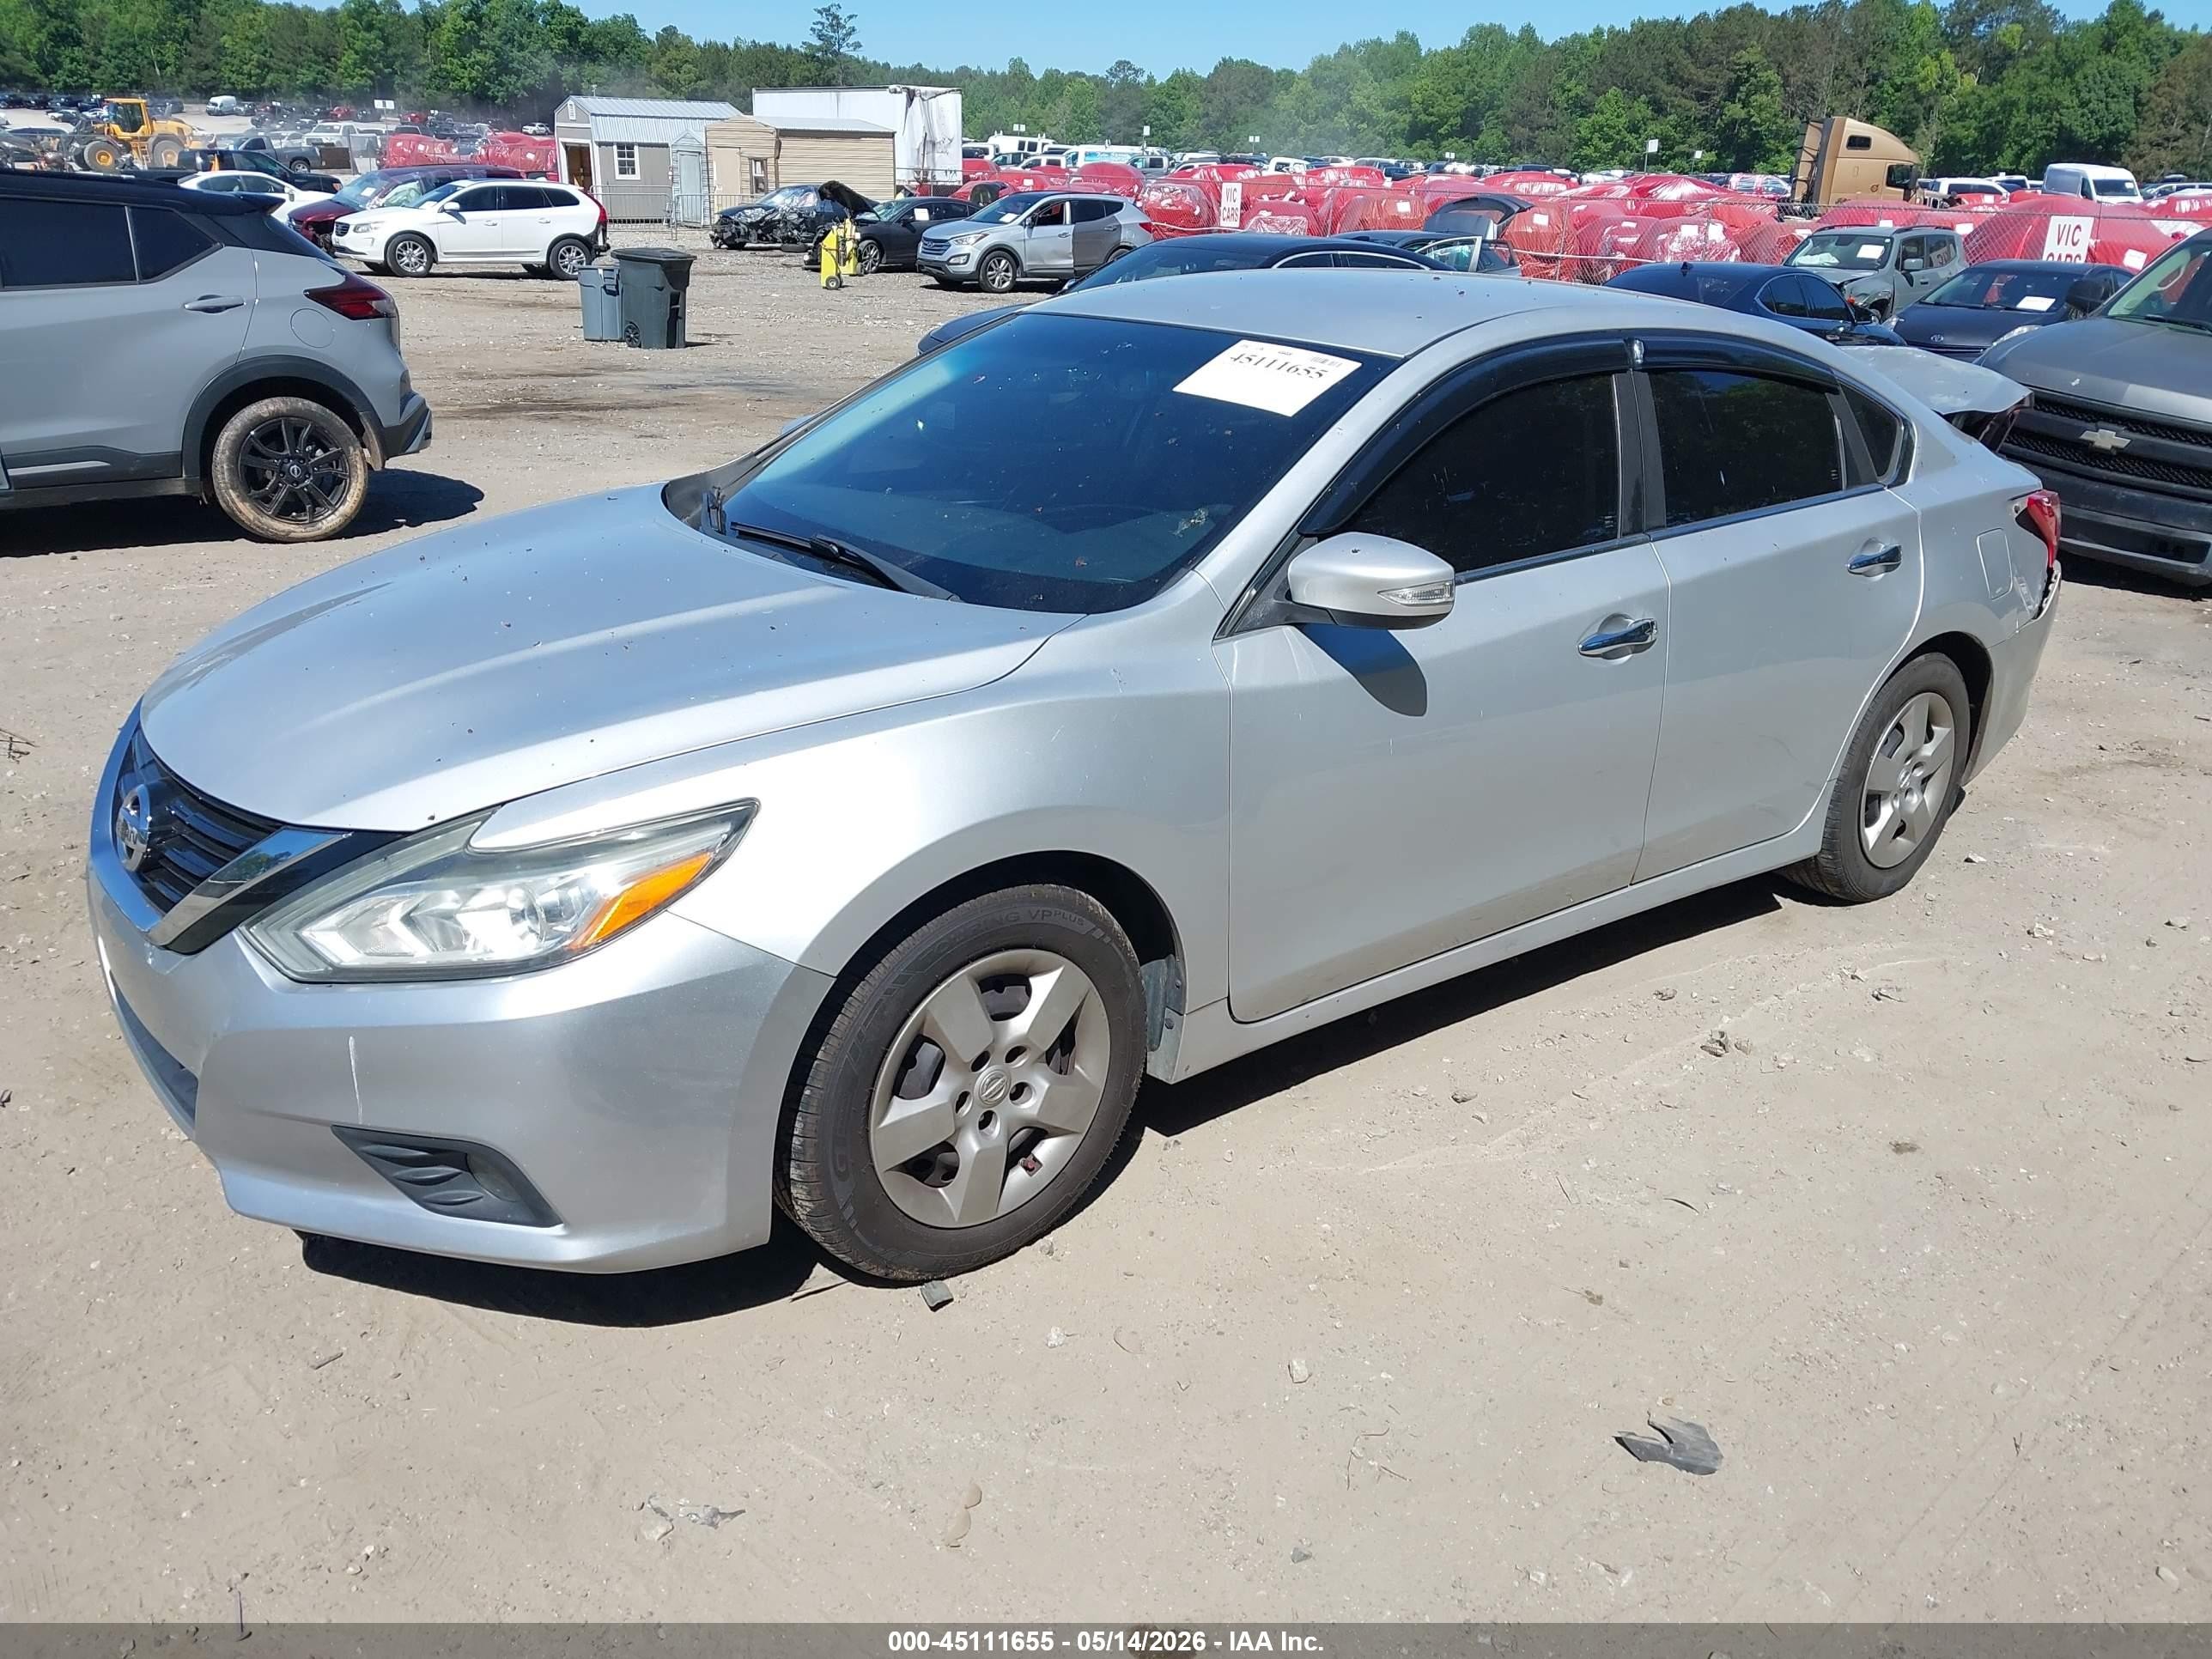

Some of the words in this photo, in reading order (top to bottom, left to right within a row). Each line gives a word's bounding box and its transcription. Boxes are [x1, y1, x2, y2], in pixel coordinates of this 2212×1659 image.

[1225, 187, 1237, 203] VIC
[1222, 206, 1238, 222] CARS
[2057, 223, 2081, 246] VIC
[1230, 353, 1328, 379] 45111655
